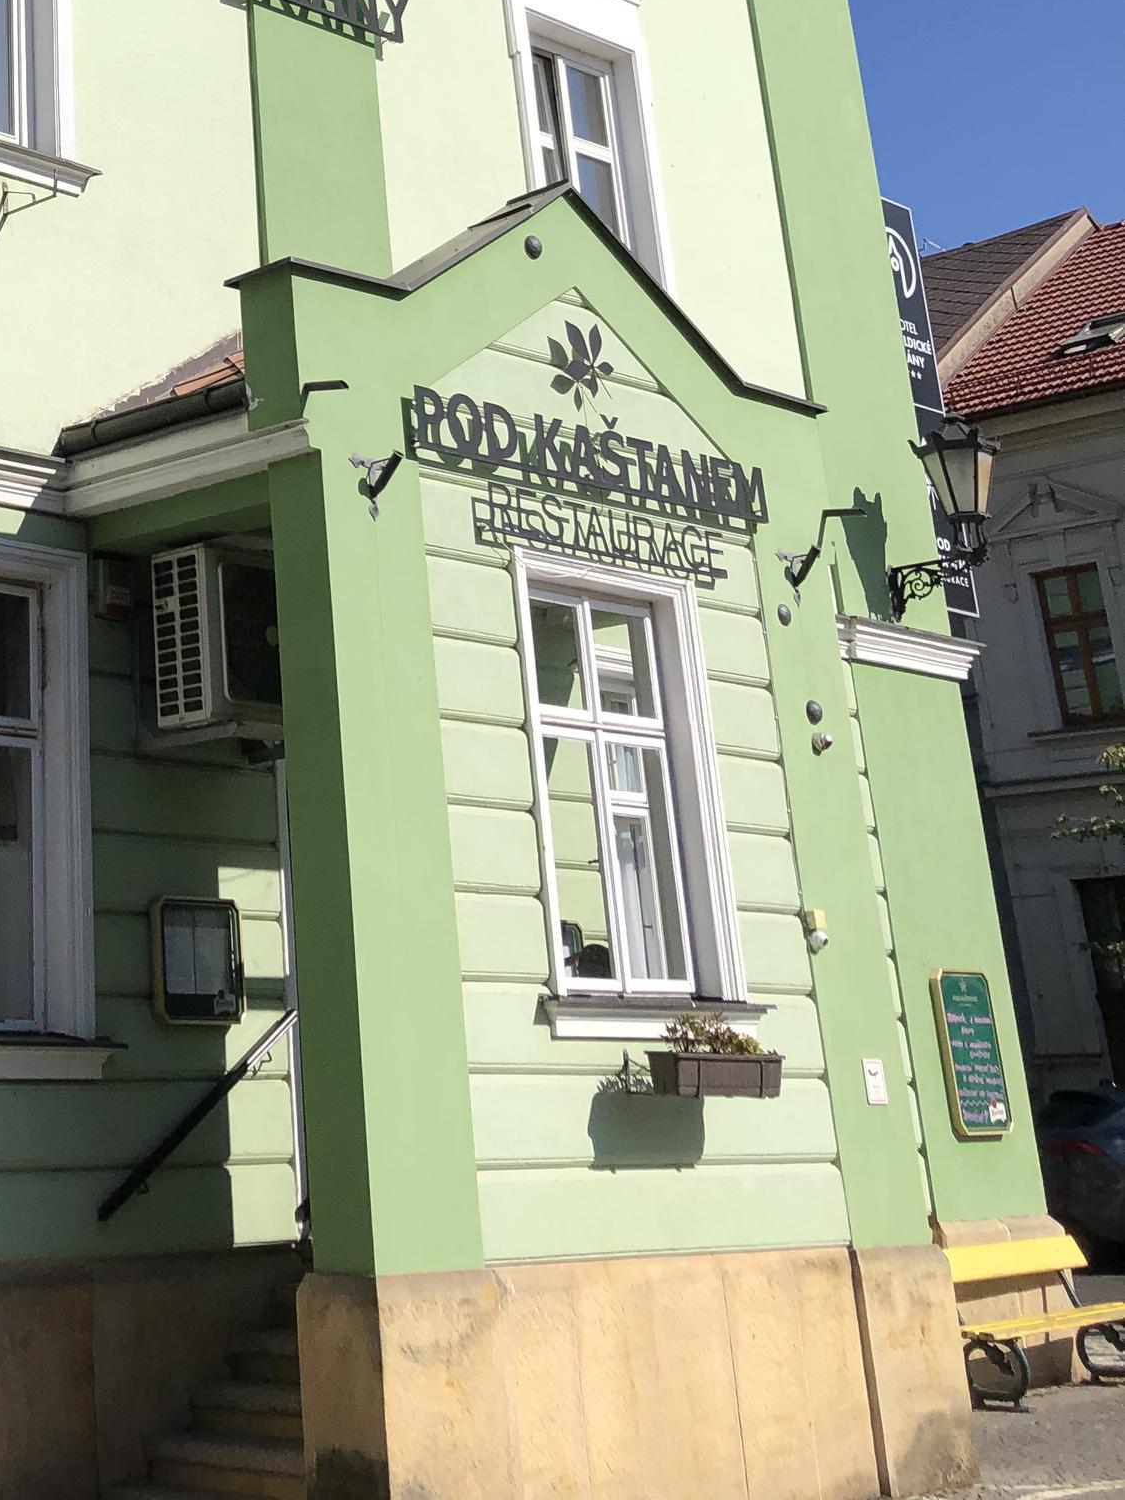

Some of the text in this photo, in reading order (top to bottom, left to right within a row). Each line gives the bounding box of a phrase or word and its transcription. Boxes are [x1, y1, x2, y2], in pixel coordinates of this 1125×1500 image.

[899, 318, 918, 335] OTEL
[903, 335, 932, 355] LDICKÉ
[907, 349, 925, 368] ÁNY
[414, 384, 768, 523] POD KAŠTANEM
[484, 482, 727, 579] RESTAURACE
[936, 537, 951, 551] OD
